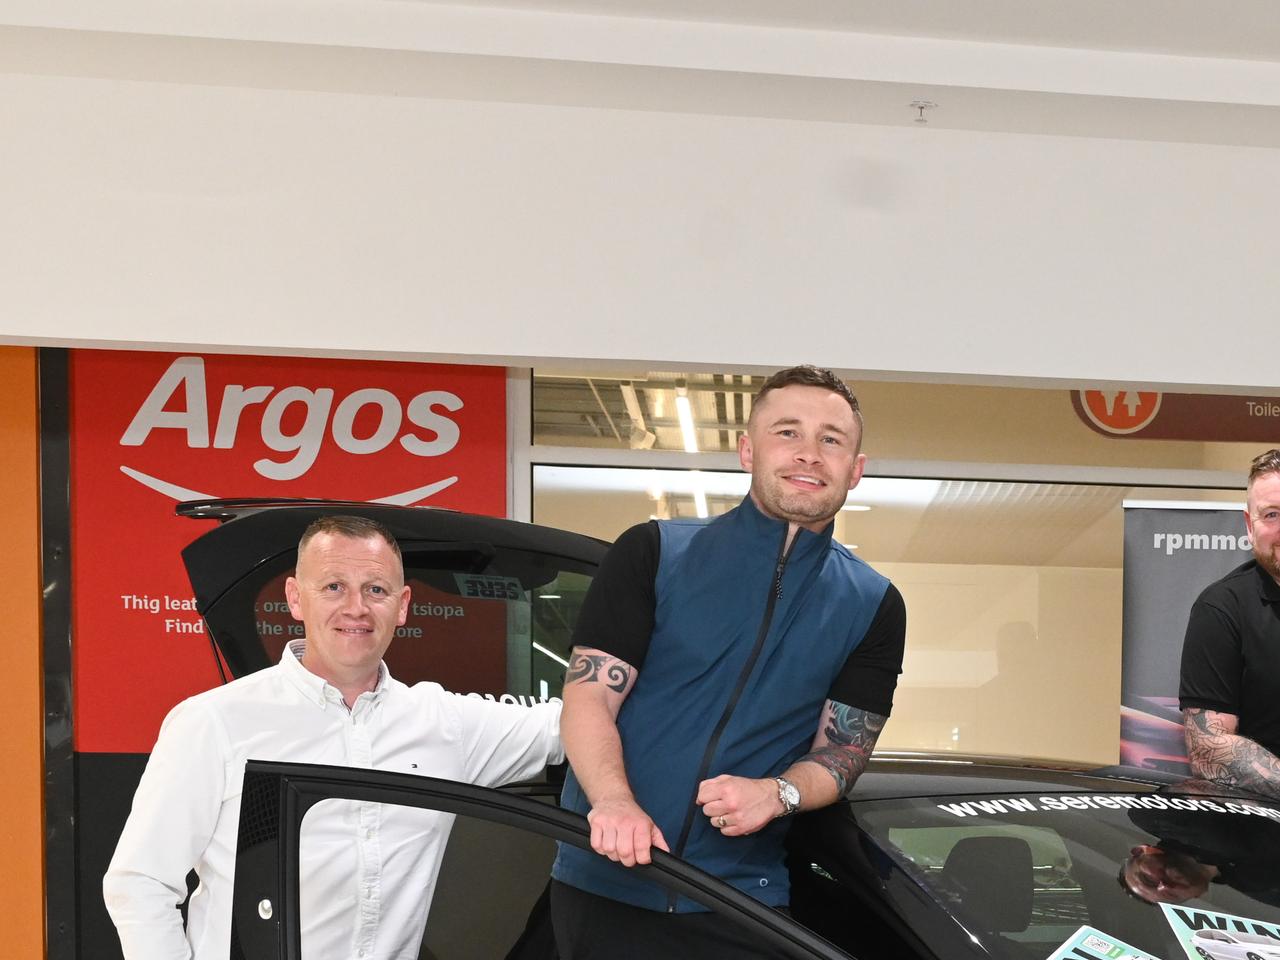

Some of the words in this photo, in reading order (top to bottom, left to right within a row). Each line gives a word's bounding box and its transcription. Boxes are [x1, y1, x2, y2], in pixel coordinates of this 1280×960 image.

[120, 356, 464, 481] Argos
[121, 595, 160, 613] Thig
[413, 603, 465, 619] tsiopa
[165, 618, 204, 634] Find
